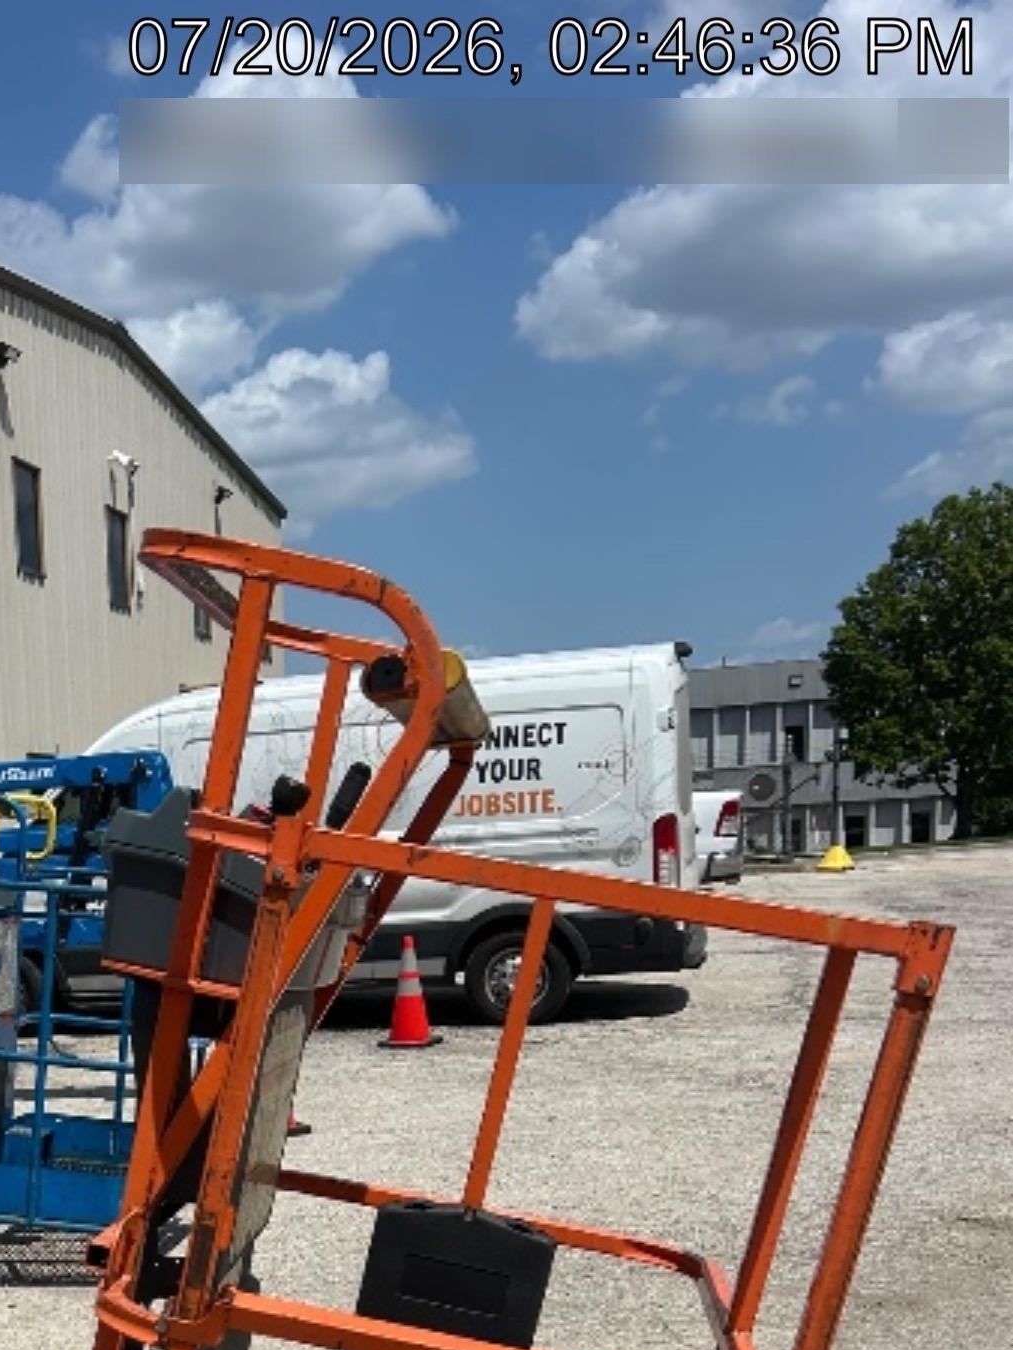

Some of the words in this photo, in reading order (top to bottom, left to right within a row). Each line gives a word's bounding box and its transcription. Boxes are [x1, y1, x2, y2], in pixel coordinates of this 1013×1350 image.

[478, 722, 567, 750] NNECT
[475, 758, 542, 783] YOUR
[454, 789, 563, 816] JOBSITE.
